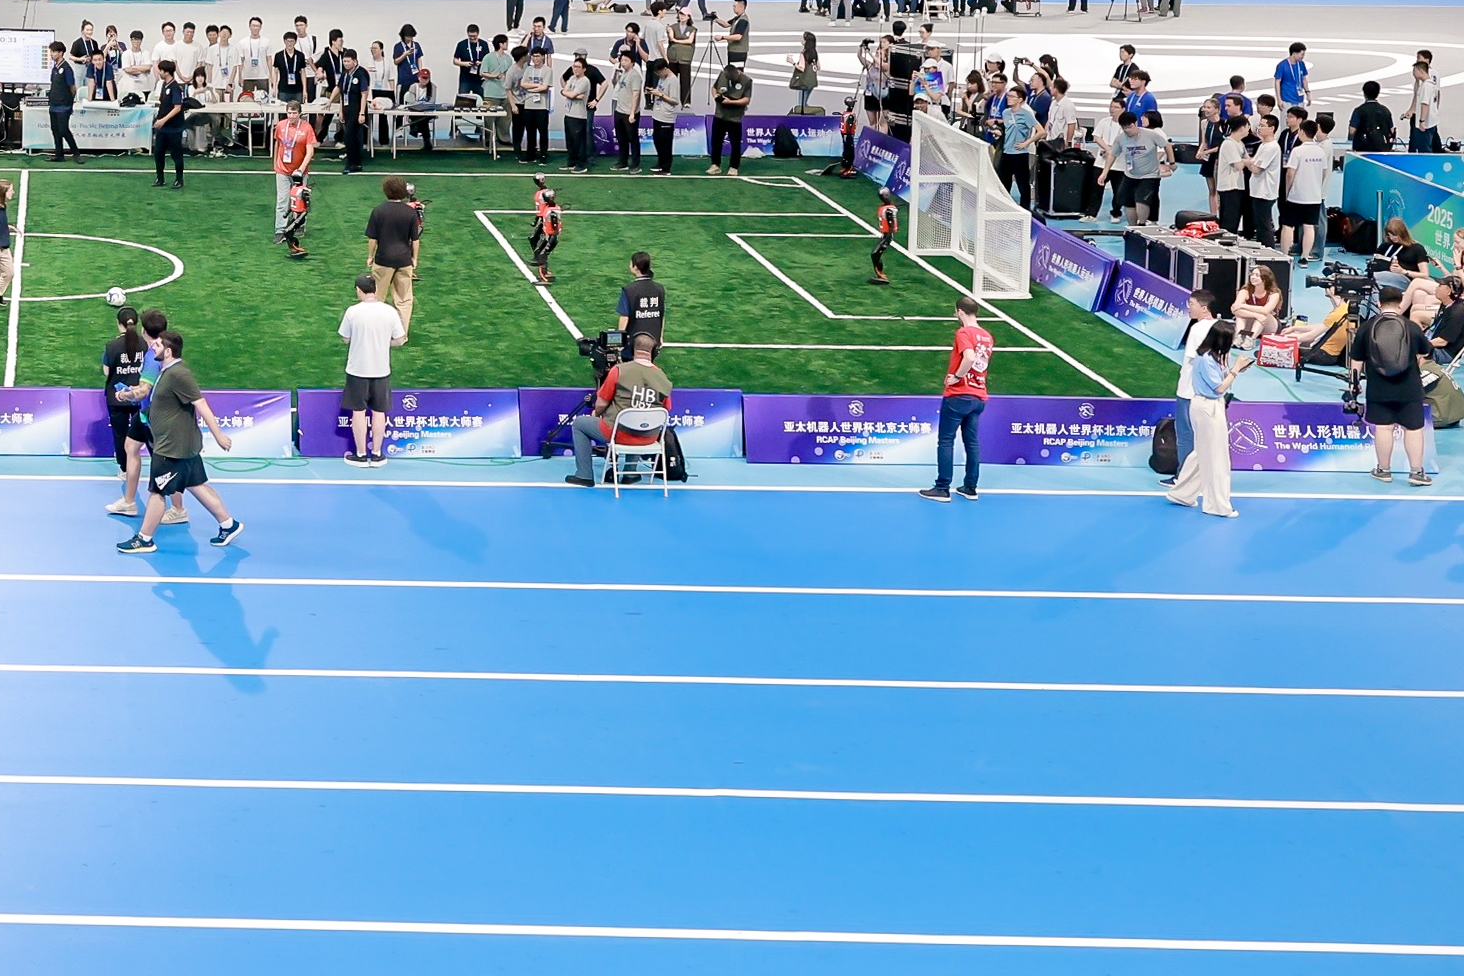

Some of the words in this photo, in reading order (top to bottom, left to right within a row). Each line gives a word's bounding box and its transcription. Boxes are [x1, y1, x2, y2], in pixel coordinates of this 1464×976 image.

[1427, 204, 1453, 230] 2025
[635, 310, 660, 319] Referee
[632, 385, 656, 403] HB
[784, 421, 932, 434] 亚太机器人世界杯北京大师赛
[1011, 422, 1156, 436] 亚太机器人世界杯北京大师
[393, 431, 420, 439] Beijing
[816, 435, 839, 444] RCAP
[840, 436, 868, 445] Beijing
[868, 436, 900, 444] Masters
[1043, 437, 1066, 446] RCAP
[1068, 438, 1095, 447] Beijing
[1096, 438, 1129, 447] Masters
[1274, 441, 1292, 449] The
[1293, 442, 1316, 450] World
[1320, 442, 1363, 451] Humanoid
